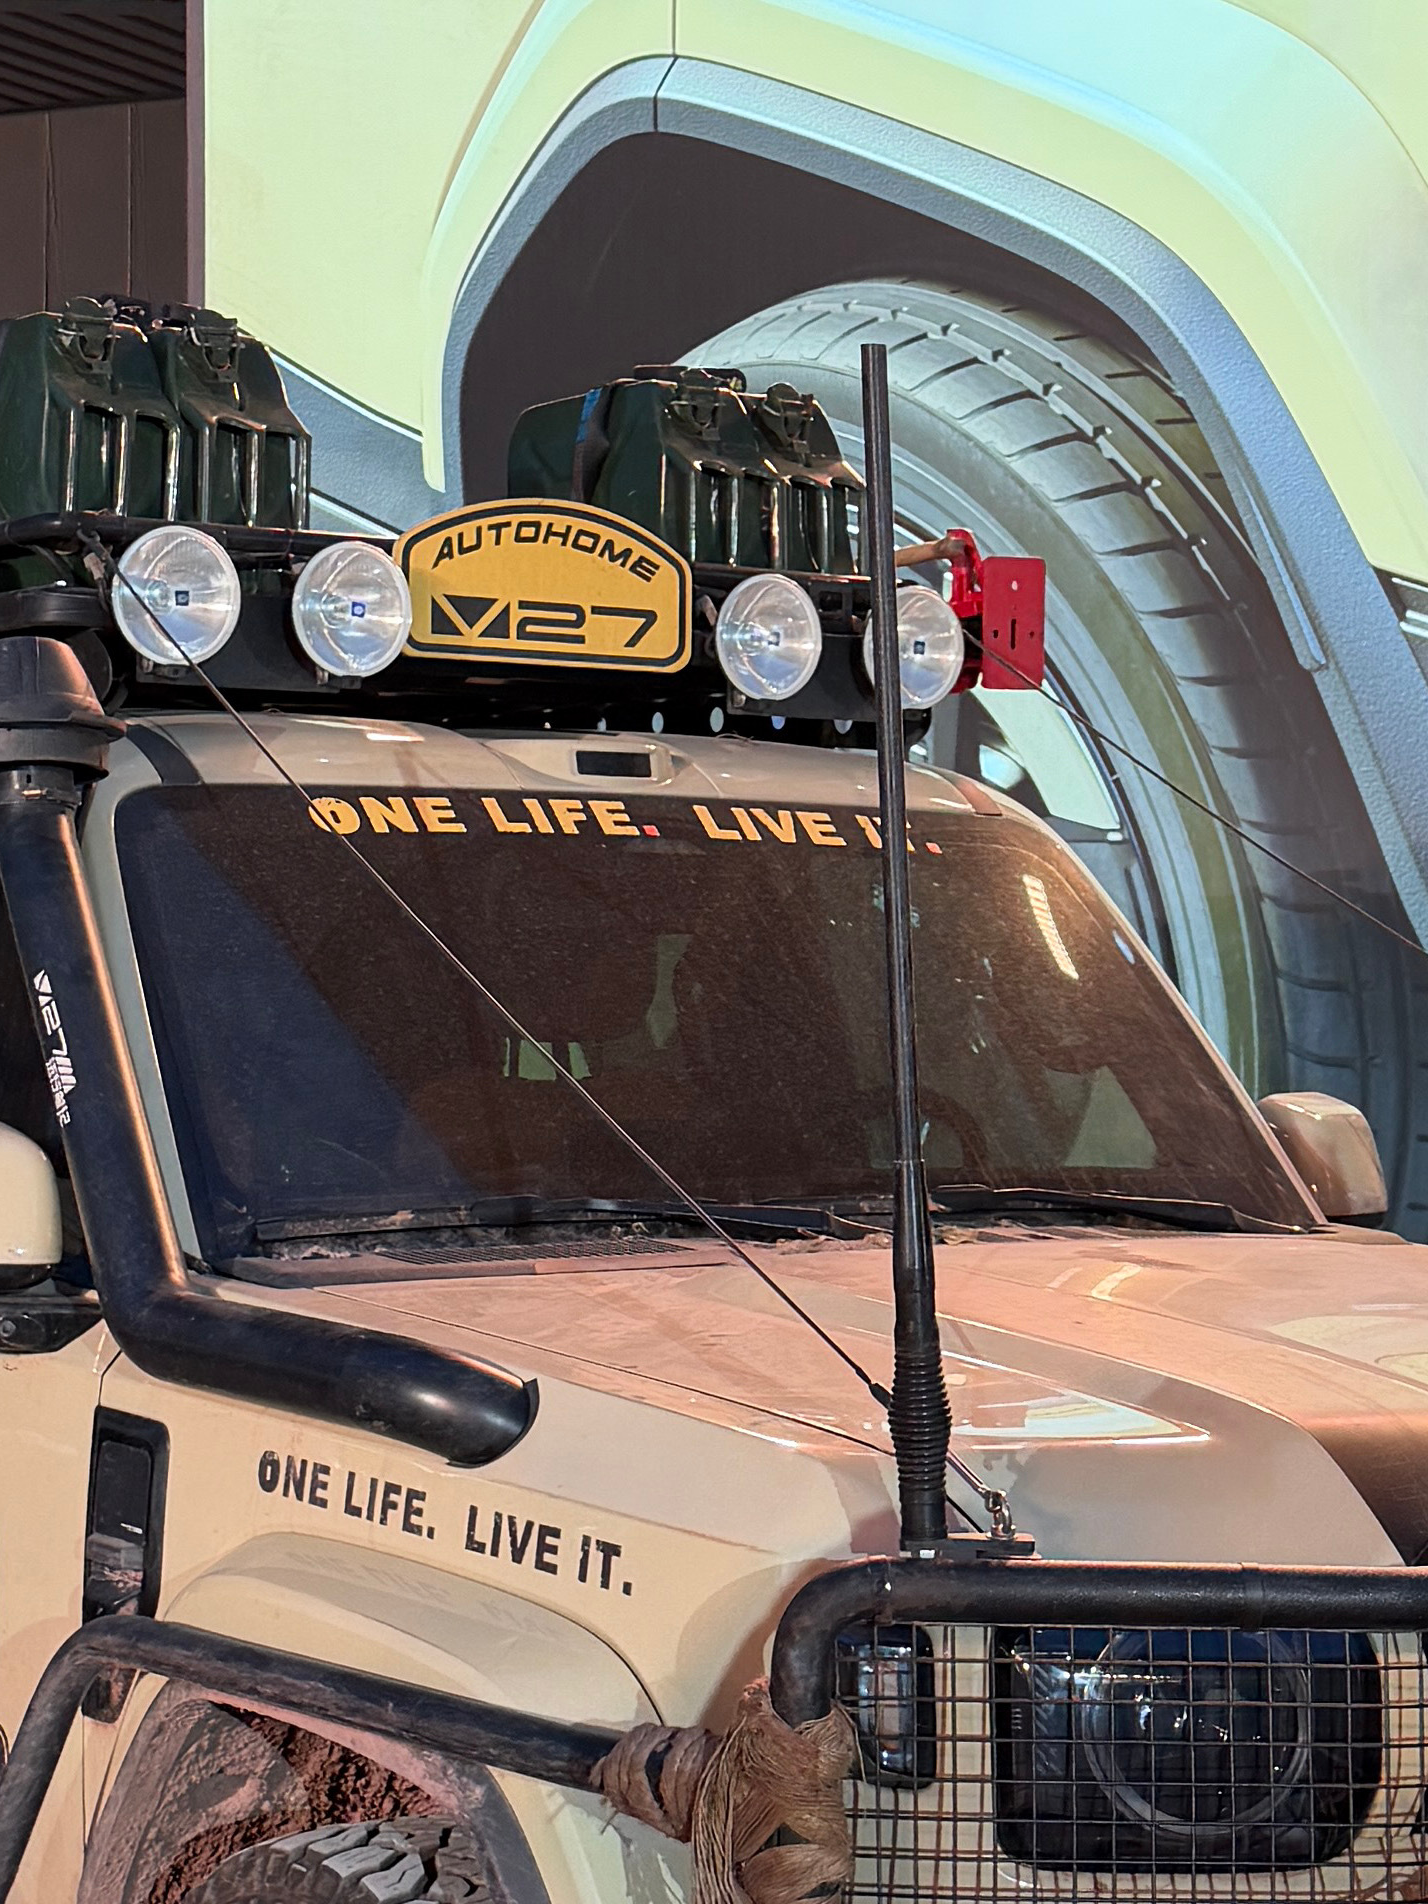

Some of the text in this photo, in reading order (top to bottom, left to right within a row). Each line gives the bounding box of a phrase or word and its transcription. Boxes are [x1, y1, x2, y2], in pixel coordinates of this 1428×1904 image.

[432, 520, 661, 584] AUTOHOME
[431, 594, 658, 649] V27
[308, 797, 466, 836] ONE
[481, 797, 660, 837] LIFE.
[692, 804, 847, 848] LIVE
[258, 1450, 633, 1596] ONE LIFE. LIVE IT.
